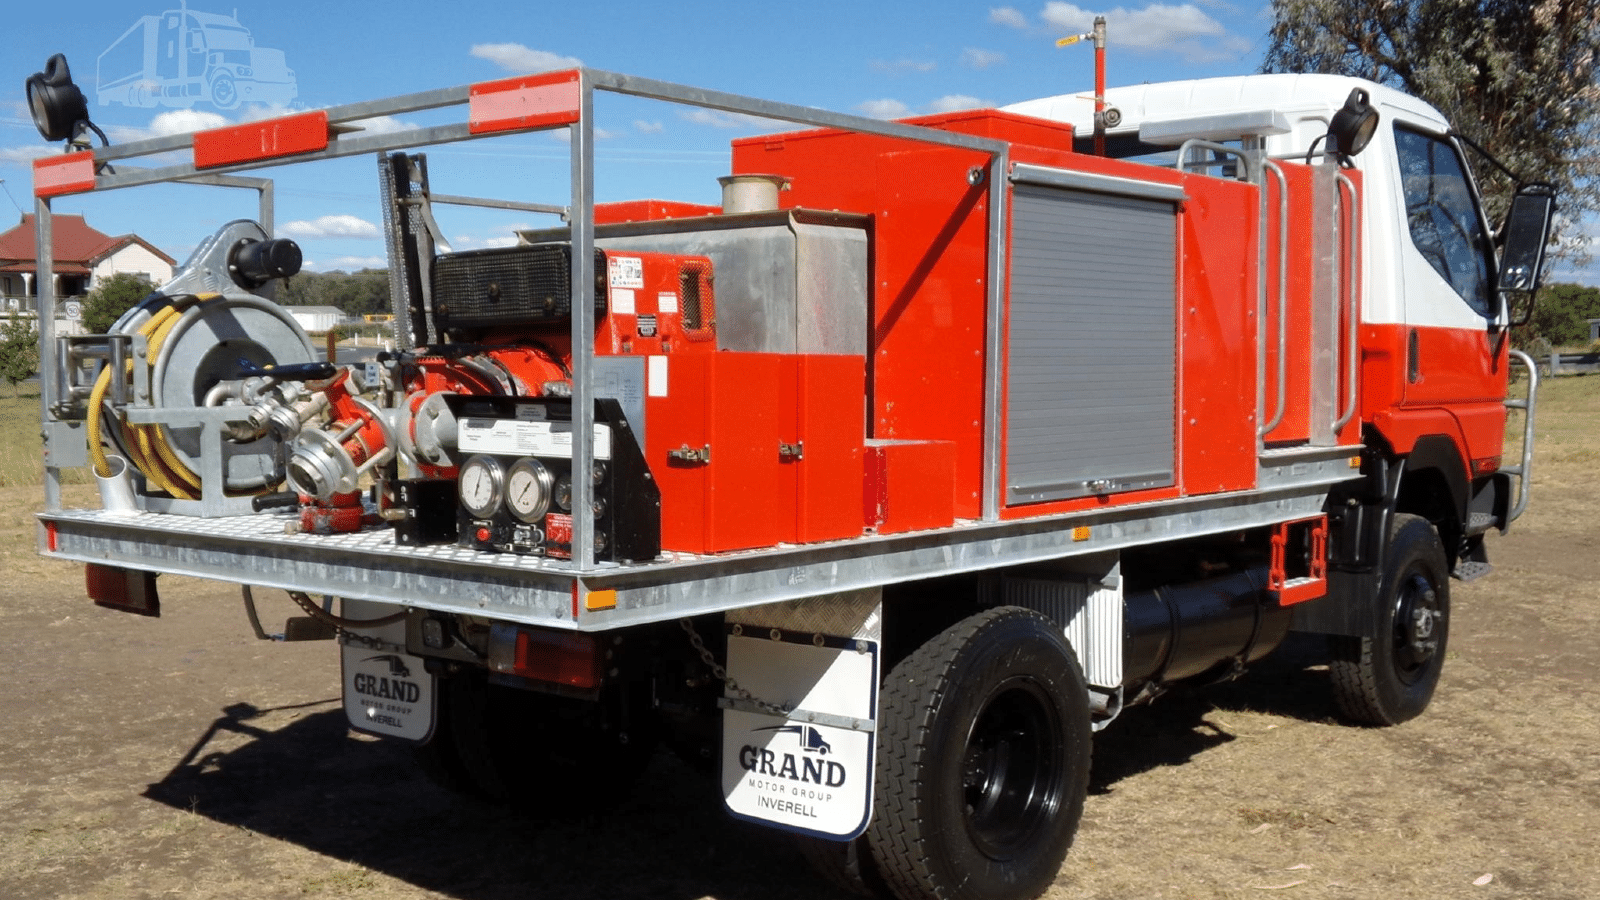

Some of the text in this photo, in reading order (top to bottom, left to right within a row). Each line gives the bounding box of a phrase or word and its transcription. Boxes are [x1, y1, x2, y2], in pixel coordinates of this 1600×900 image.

[354, 673, 420, 703] GRAND
[360, 699, 412, 714] MOTOR GROUP
[739, 744, 846, 788] GRAND
[748, 778, 832, 802] MOTOR GROUP
[757, 795, 818, 818] INVERELL
